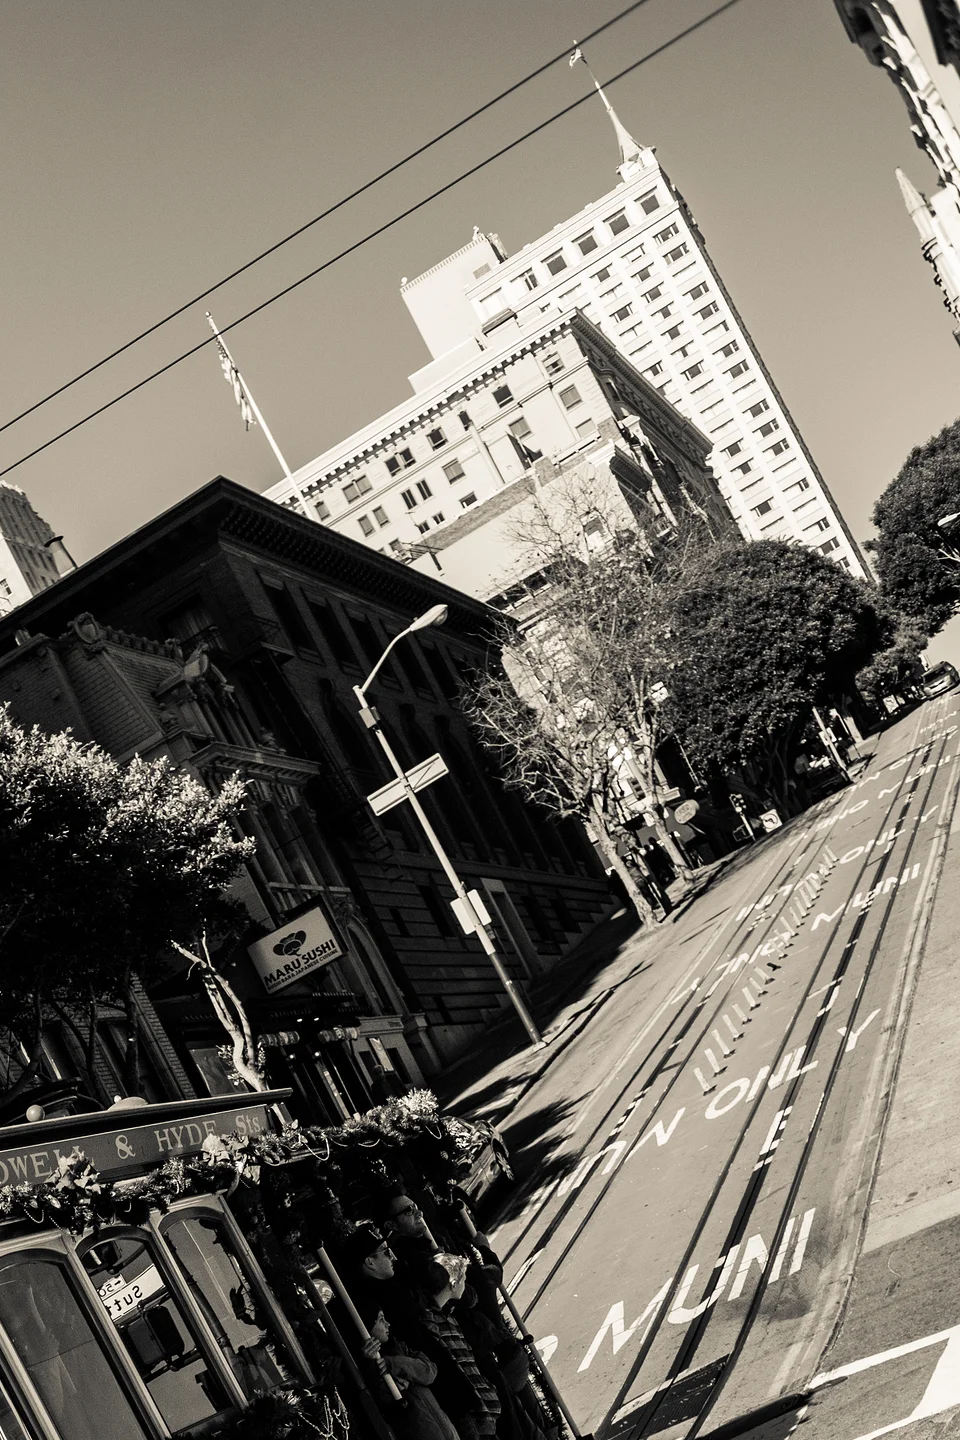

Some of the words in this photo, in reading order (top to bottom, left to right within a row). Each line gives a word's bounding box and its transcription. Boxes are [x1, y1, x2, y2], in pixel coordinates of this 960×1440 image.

[263, 958, 302, 986] MARU
[301, 939, 336, 965] SUSHI
[704, 1008, 880, 1120] ONLY
[114, 1135, 136, 1160] &
[153, 1119, 218, 1153] HYDE
[577, 1208, 816, 1372] MUNI
